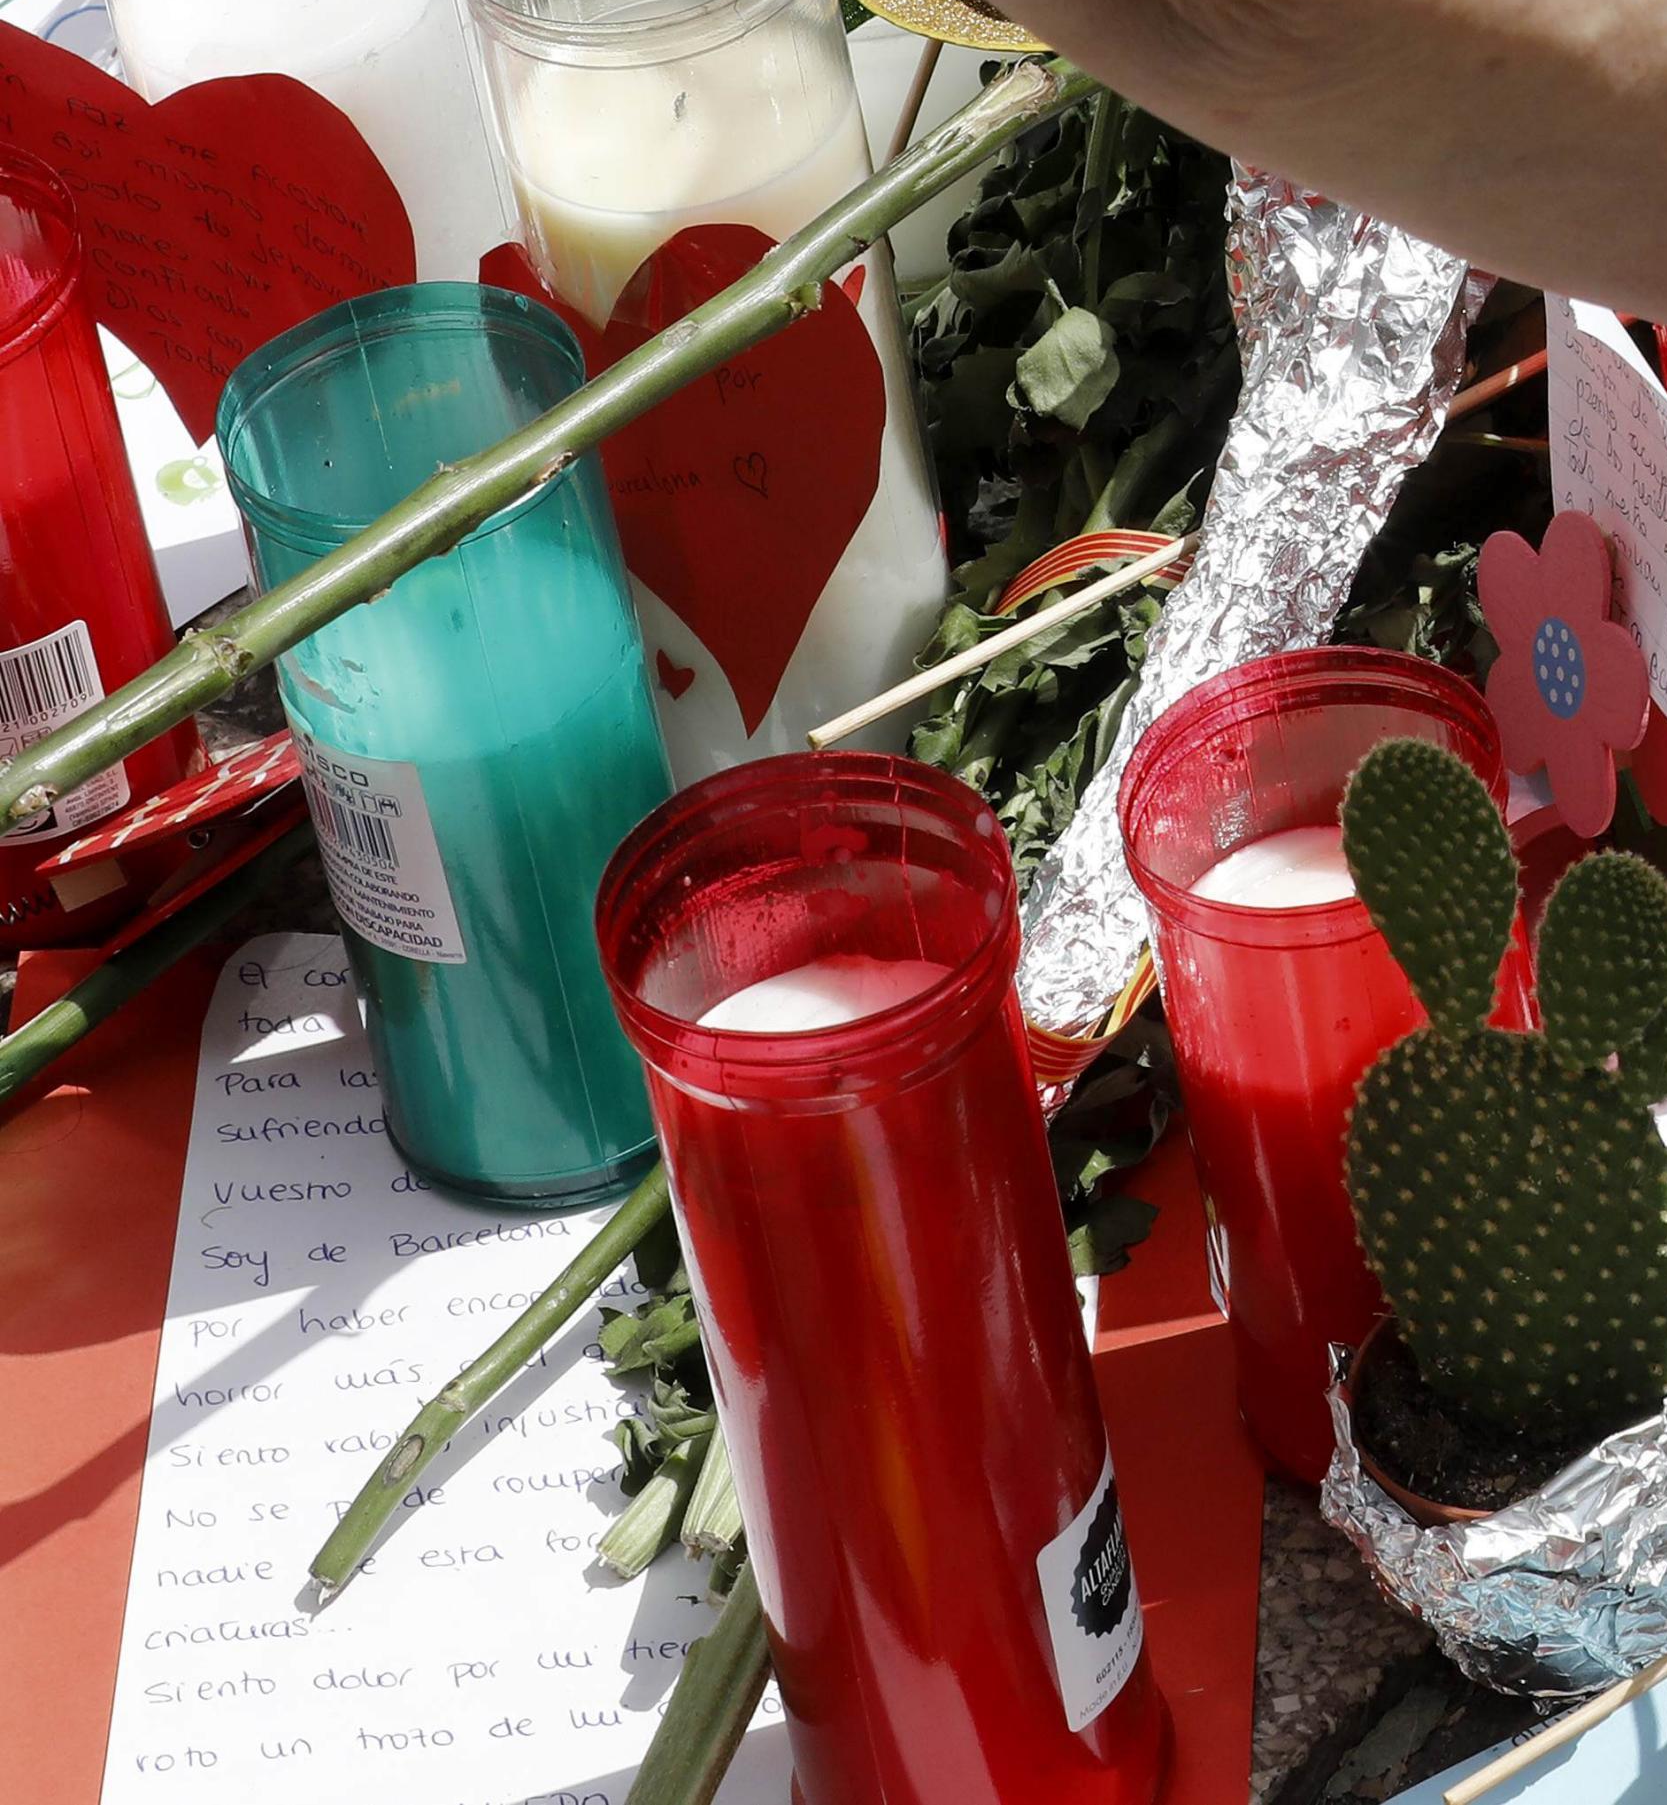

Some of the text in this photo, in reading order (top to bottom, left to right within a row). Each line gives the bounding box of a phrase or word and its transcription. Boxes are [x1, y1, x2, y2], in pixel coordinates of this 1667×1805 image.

[714, 366, 763, 405] por
[608, 456, 702, 495] arcelona
[303, 967, 351, 987] cor
[238, 1011, 326, 1035] toda
[216, 1114, 387, 1143] sufriendo
[201, 1218, 571, 1287] Soy de Barcelona
[190, 1318, 243, 1348] por
[299, 1305, 411, 1334] haber
[175, 1381, 284, 1407] horror
[335, 1357, 424, 1391] más
[169, 1443, 290, 1468] Siento
[166, 1509, 217, 1528] No
[248, 1502, 290, 1521] se
[493, 1463, 622, 1495] romper
[157, 1529, 598, 1587] nadie esta for
[143, 1637, 697, 1704] Siento dolor por mi tier
[136, 1745, 218, 1773] roto
[259, 1737, 313, 1760] un
[489, 1716, 536, 1739] de
[569, 1703, 624, 1730] mi
